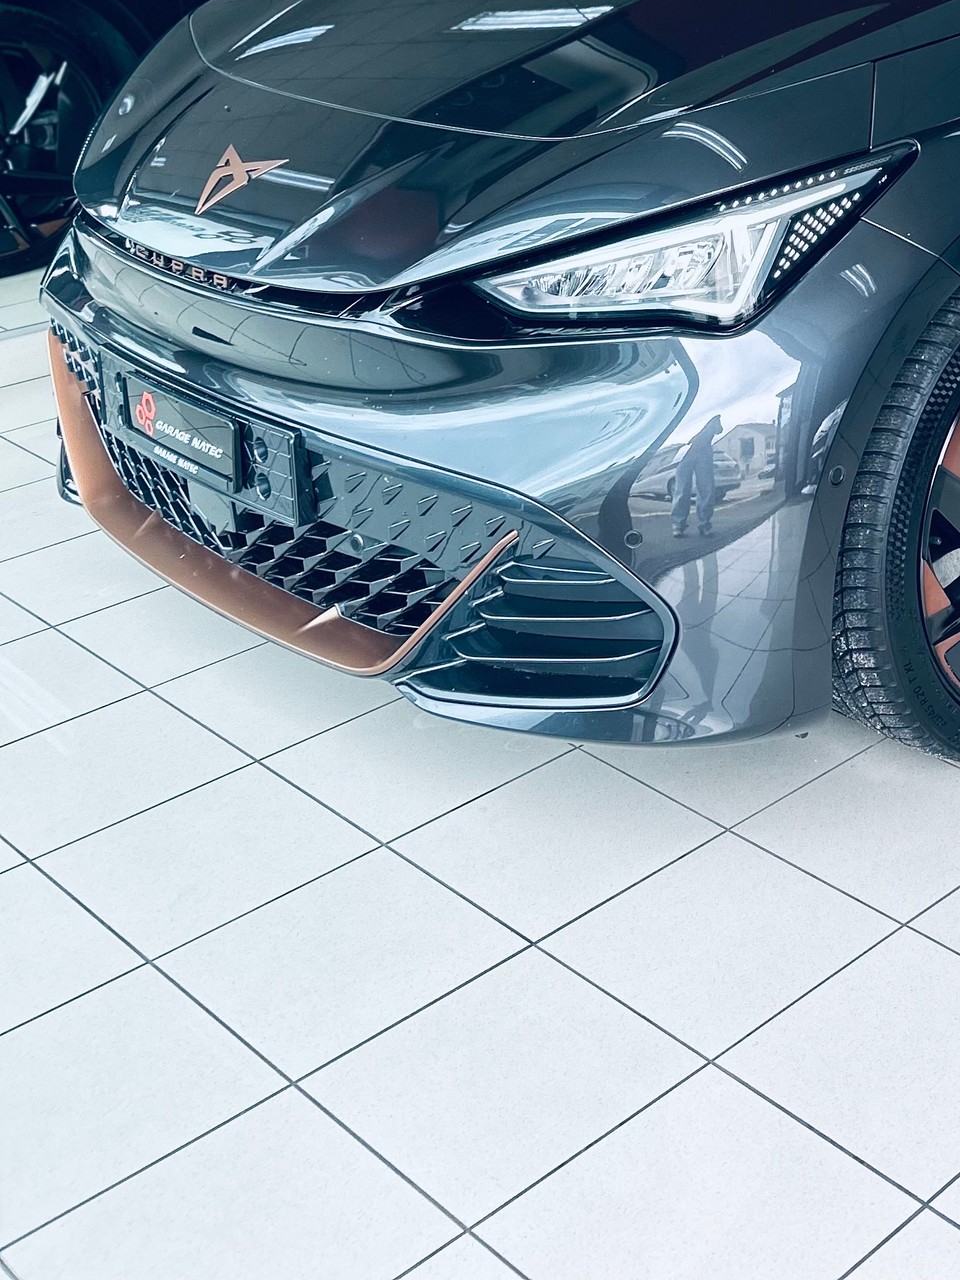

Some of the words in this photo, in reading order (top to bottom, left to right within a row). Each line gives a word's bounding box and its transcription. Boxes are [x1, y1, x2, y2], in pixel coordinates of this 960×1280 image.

[136, 244, 228, 289] CUPRA
[155, 420, 192, 444] GARAGE
[190, 437, 224, 459] NATEC
